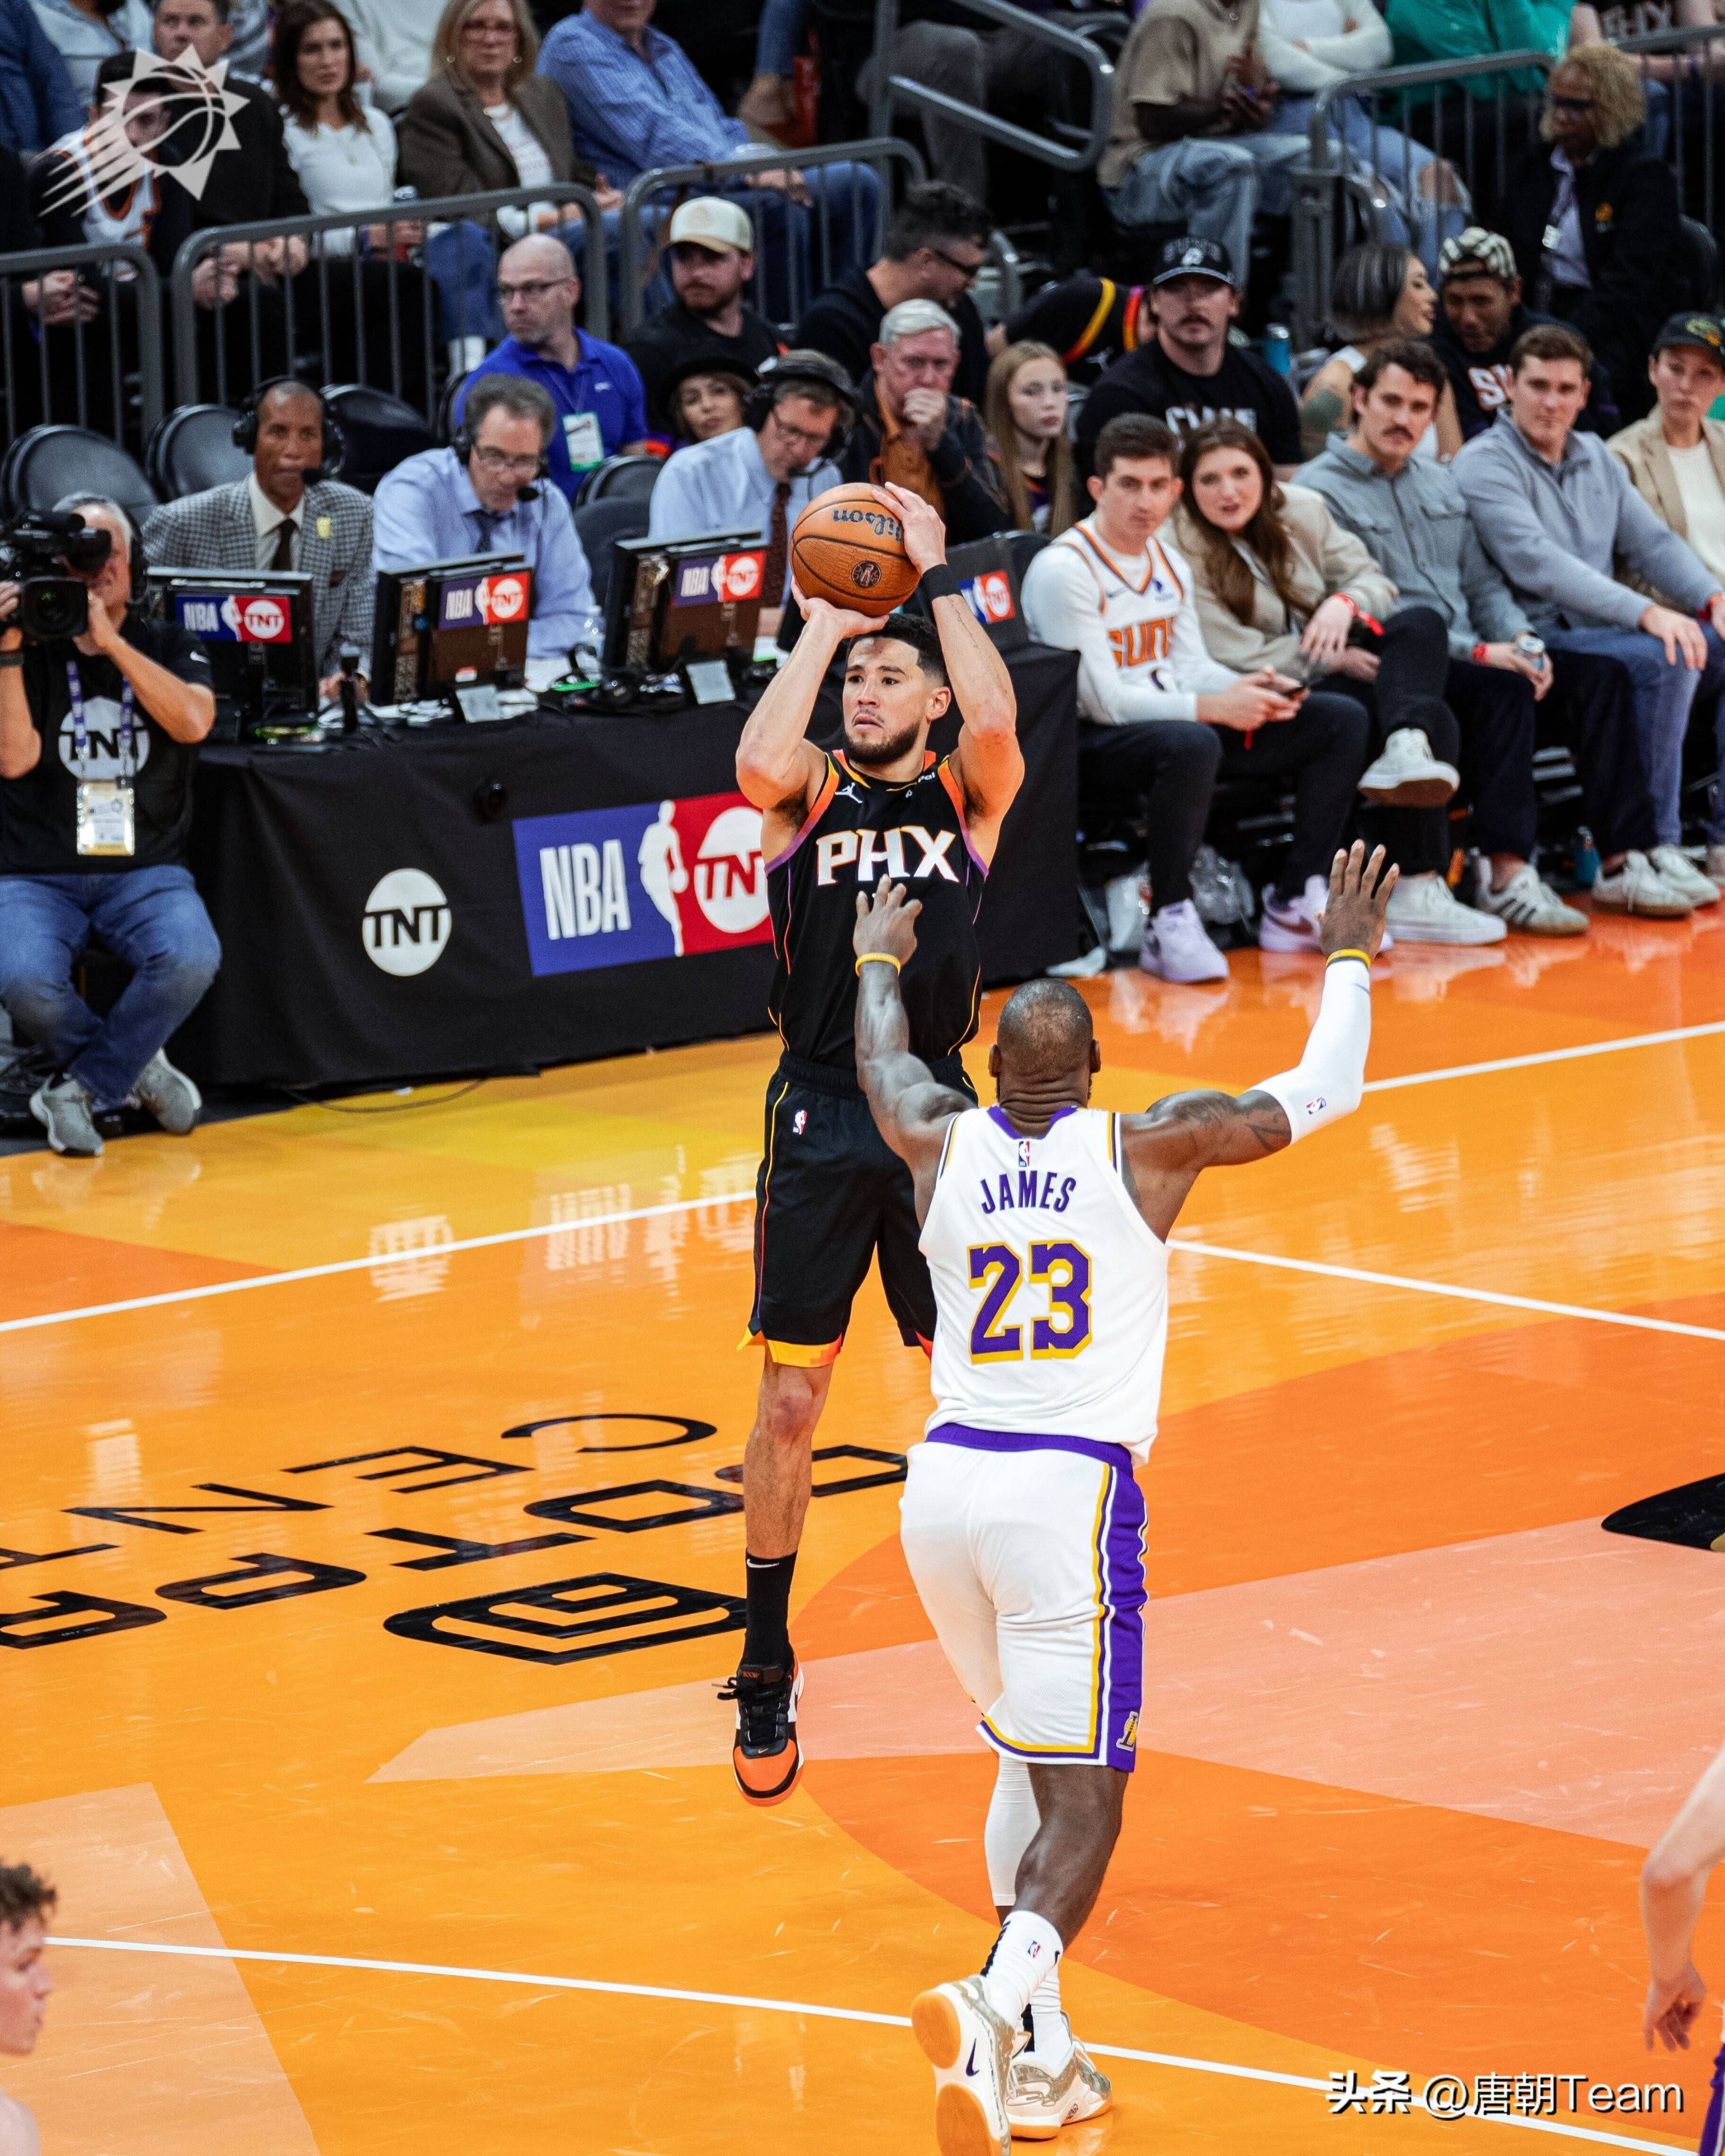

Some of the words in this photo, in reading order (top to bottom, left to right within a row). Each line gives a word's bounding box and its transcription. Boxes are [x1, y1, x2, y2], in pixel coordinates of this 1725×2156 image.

[183, 601, 220, 632] NBA
[247, 613, 282, 630] TNT
[816, 825, 960, 886] PHX
[540, 839, 632, 941] NBA
[695, 852, 762, 900] TN
[363, 905, 449, 947] TNT
[980, 1170, 1076, 1214] JAMES
[967, 1240, 1092, 1365] 23
